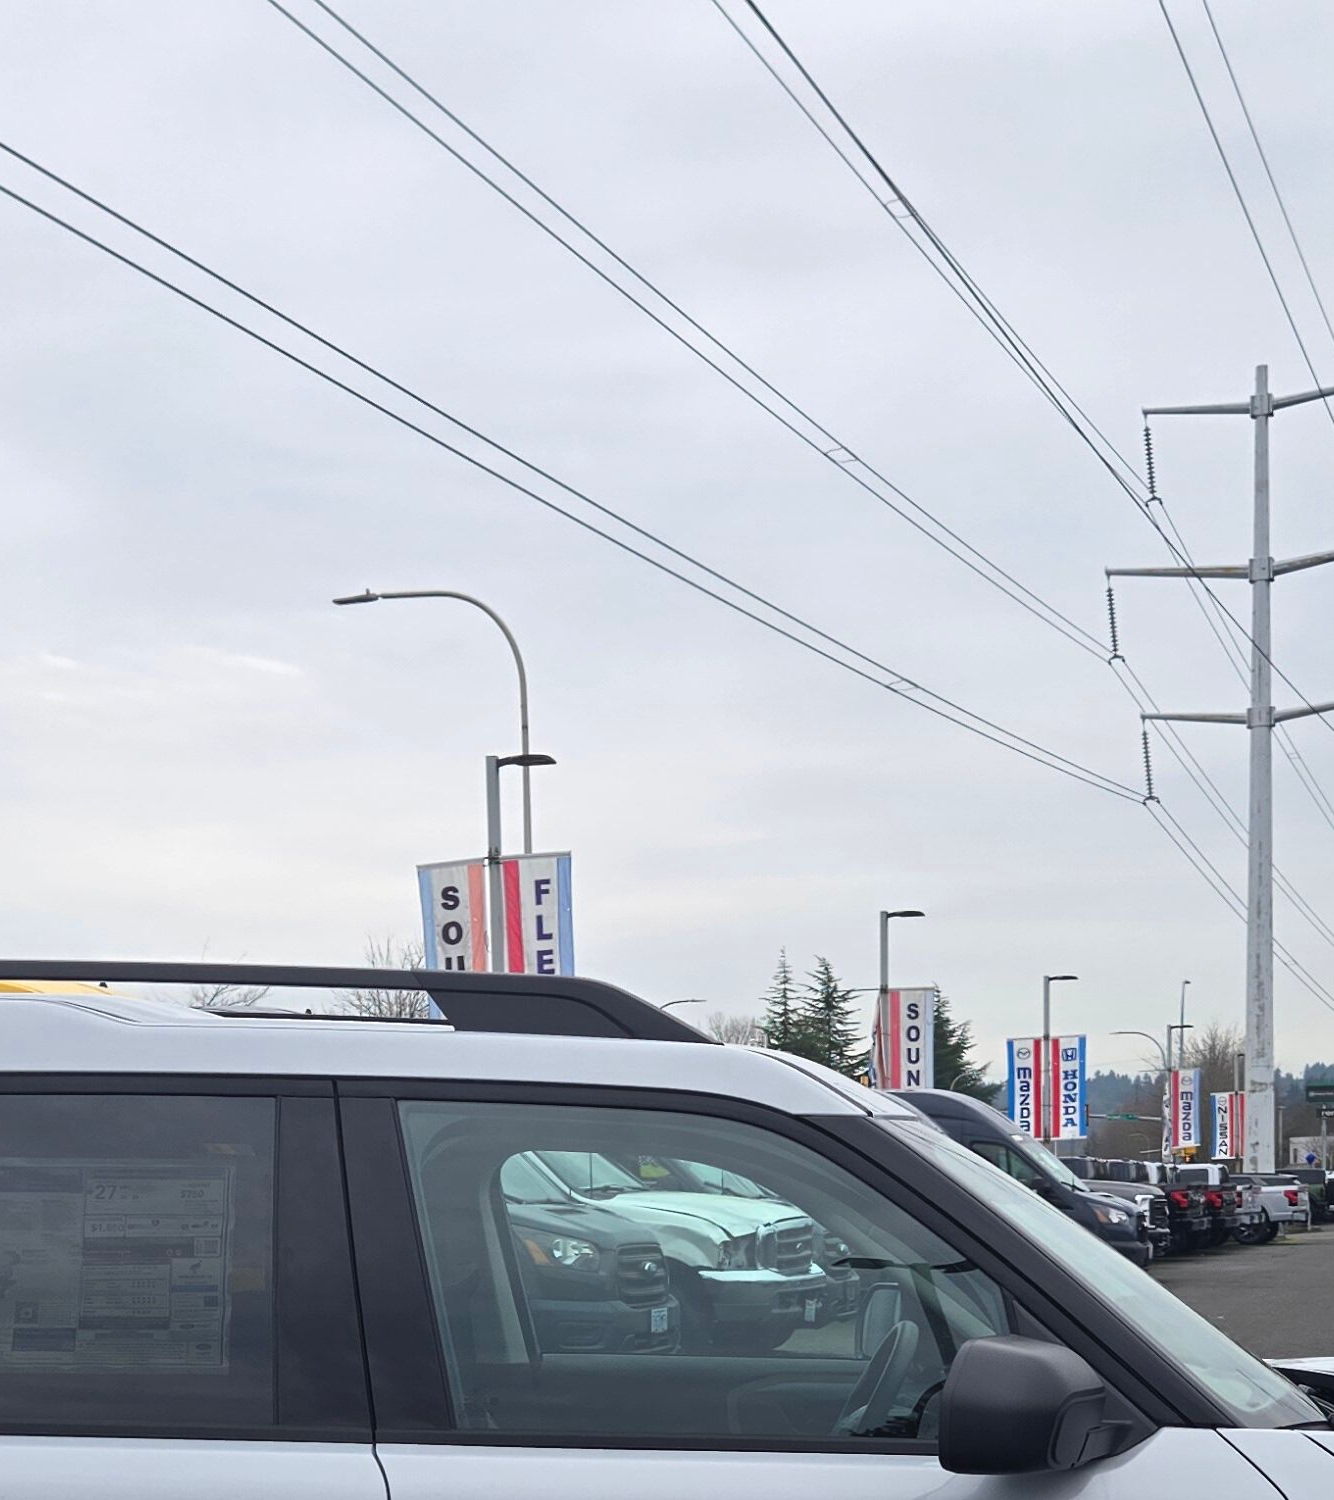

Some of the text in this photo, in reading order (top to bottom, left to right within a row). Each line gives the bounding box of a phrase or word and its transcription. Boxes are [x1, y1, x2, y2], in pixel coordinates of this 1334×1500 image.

[534, 878, 556, 976] FLE
[906, 1003, 921, 1087] SOUN
[1062, 1069, 1078, 1128] HONDA
[1217, 1106, 1228, 1156] NISSAN
